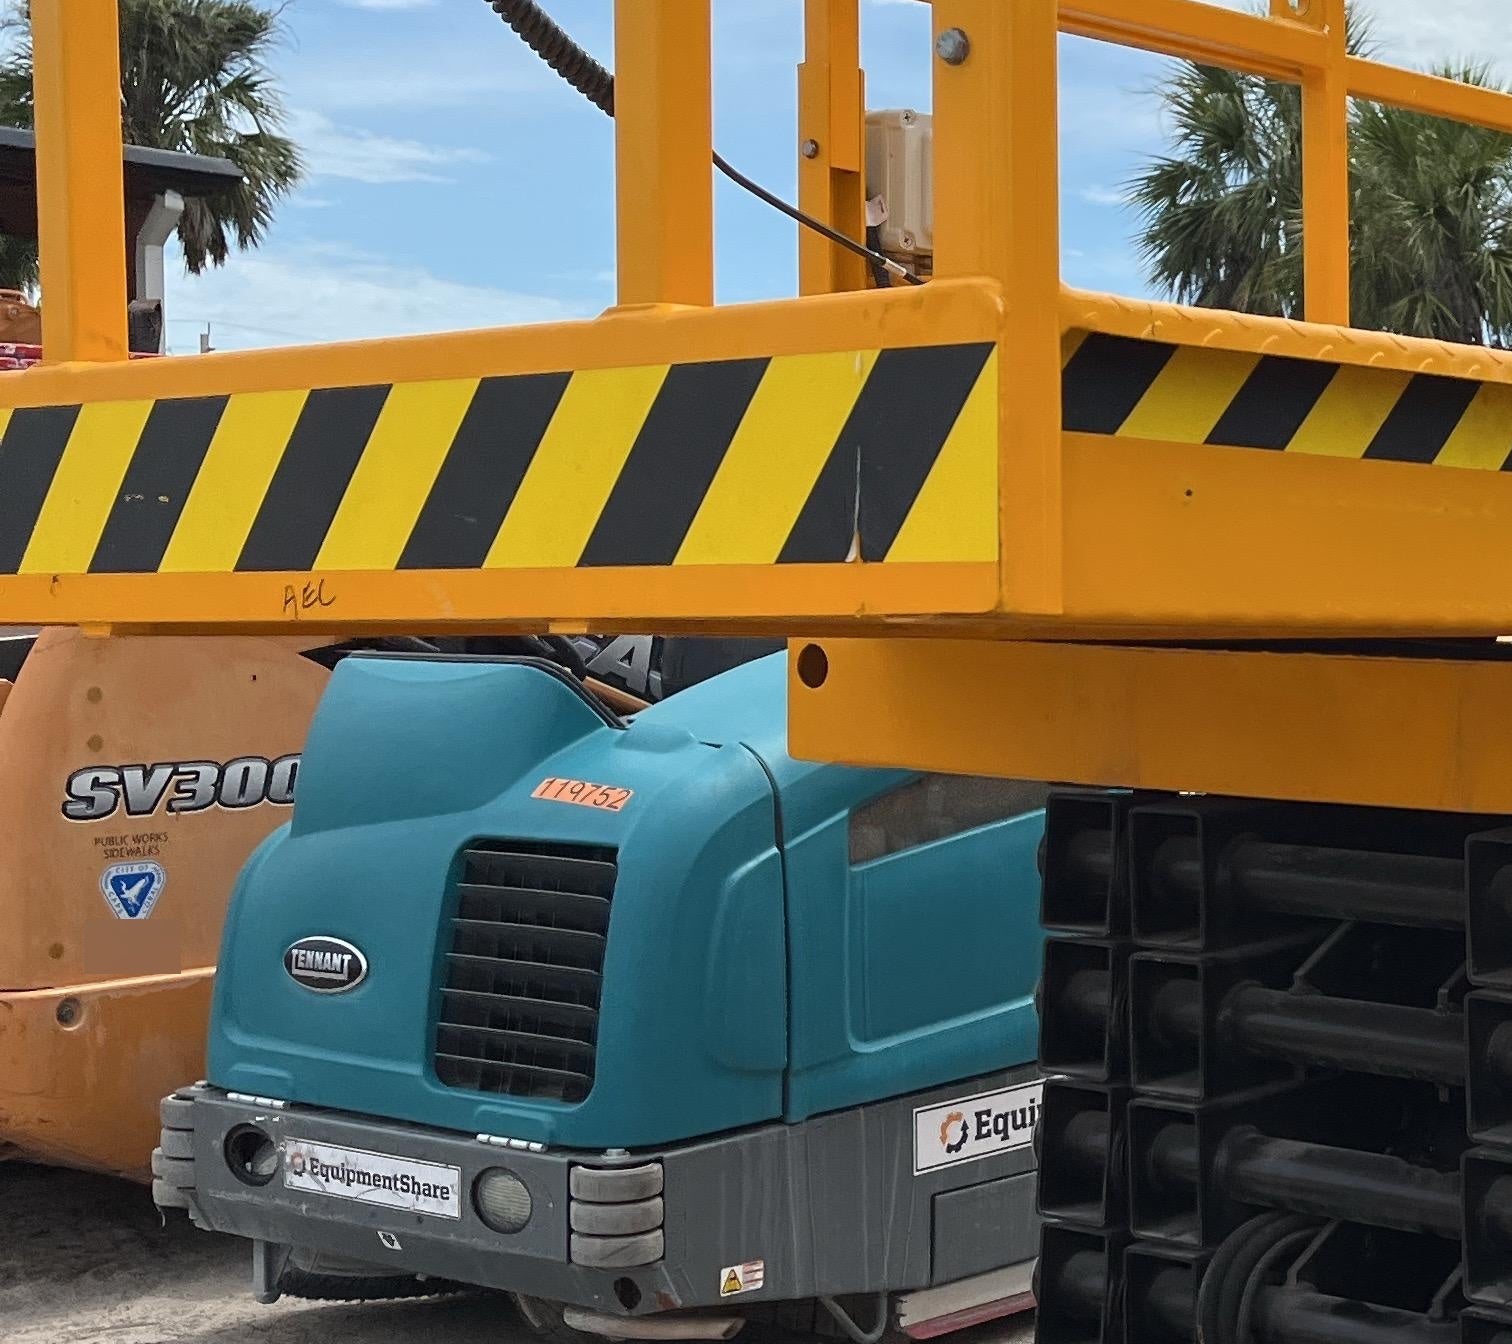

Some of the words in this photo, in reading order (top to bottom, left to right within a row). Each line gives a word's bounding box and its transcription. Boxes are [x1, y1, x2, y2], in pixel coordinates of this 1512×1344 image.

[61, 752, 303, 823] SV300
[540, 779, 630, 809] 119752
[291, 947, 352, 979] TENNANT
[309, 1157, 451, 1201] EquipmentShare
